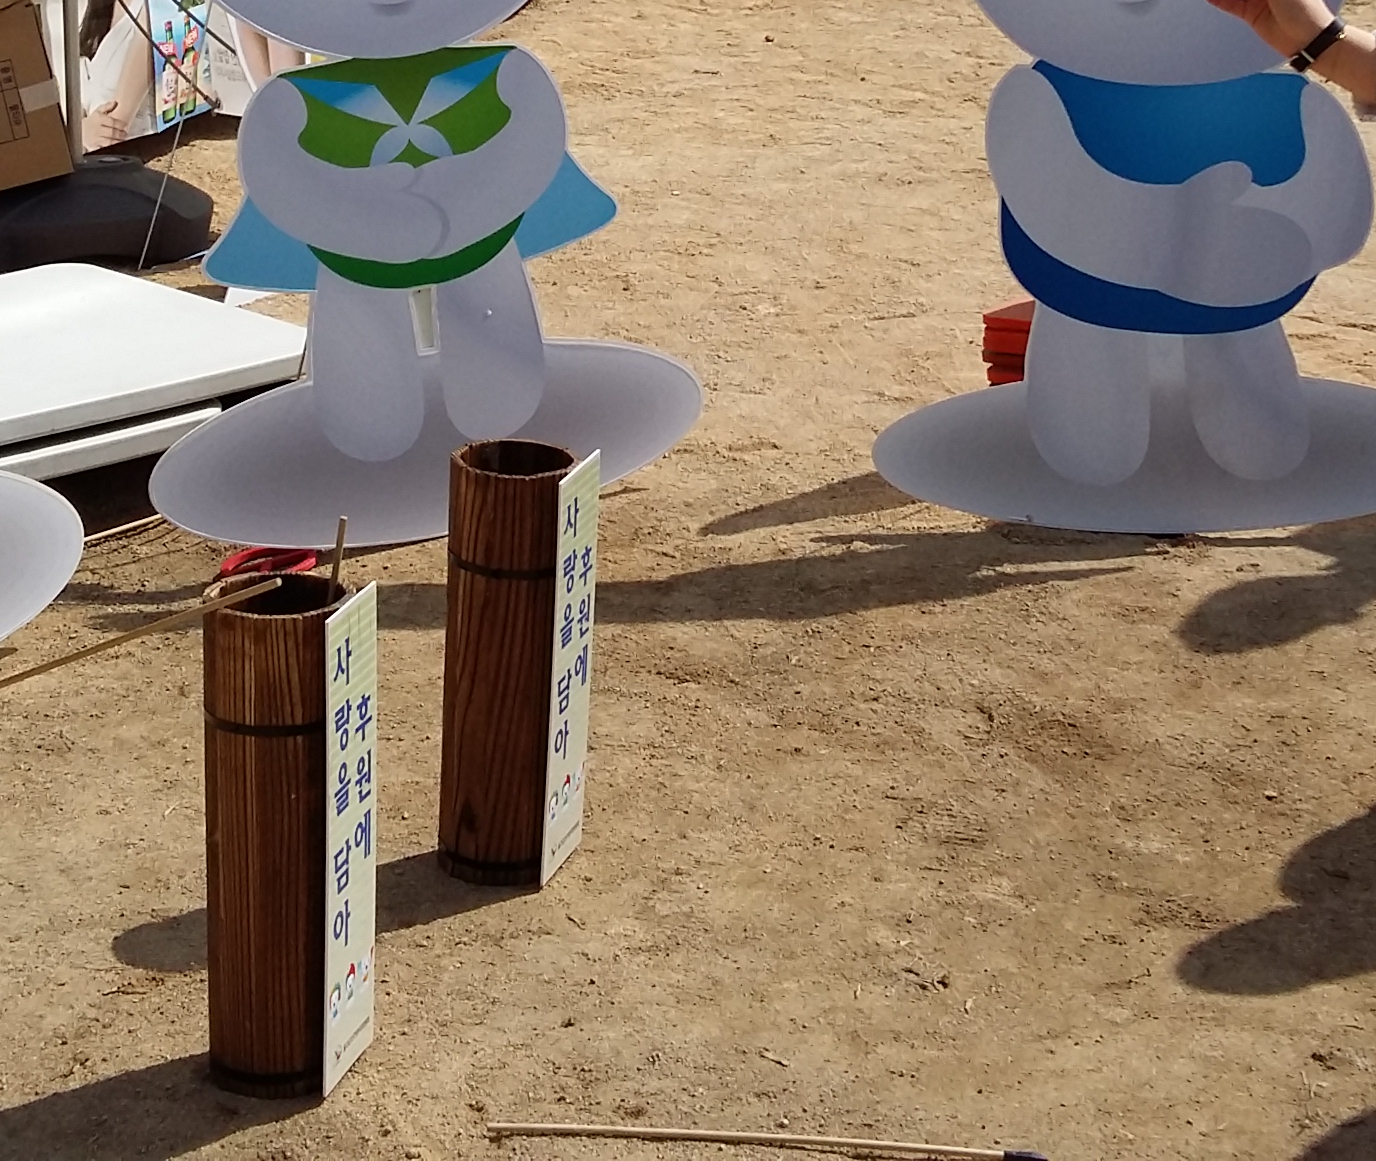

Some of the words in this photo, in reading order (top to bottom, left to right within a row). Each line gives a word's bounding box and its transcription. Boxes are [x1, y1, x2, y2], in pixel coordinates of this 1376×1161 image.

[560, 496, 579, 650] 사랑을
[574, 545, 593, 687] 후원에
[334, 636, 352, 817] 사랑을
[354, 693, 372, 859] 후원에
[554, 669, 573, 760] 담아
[333, 837, 351, 947] 담아
